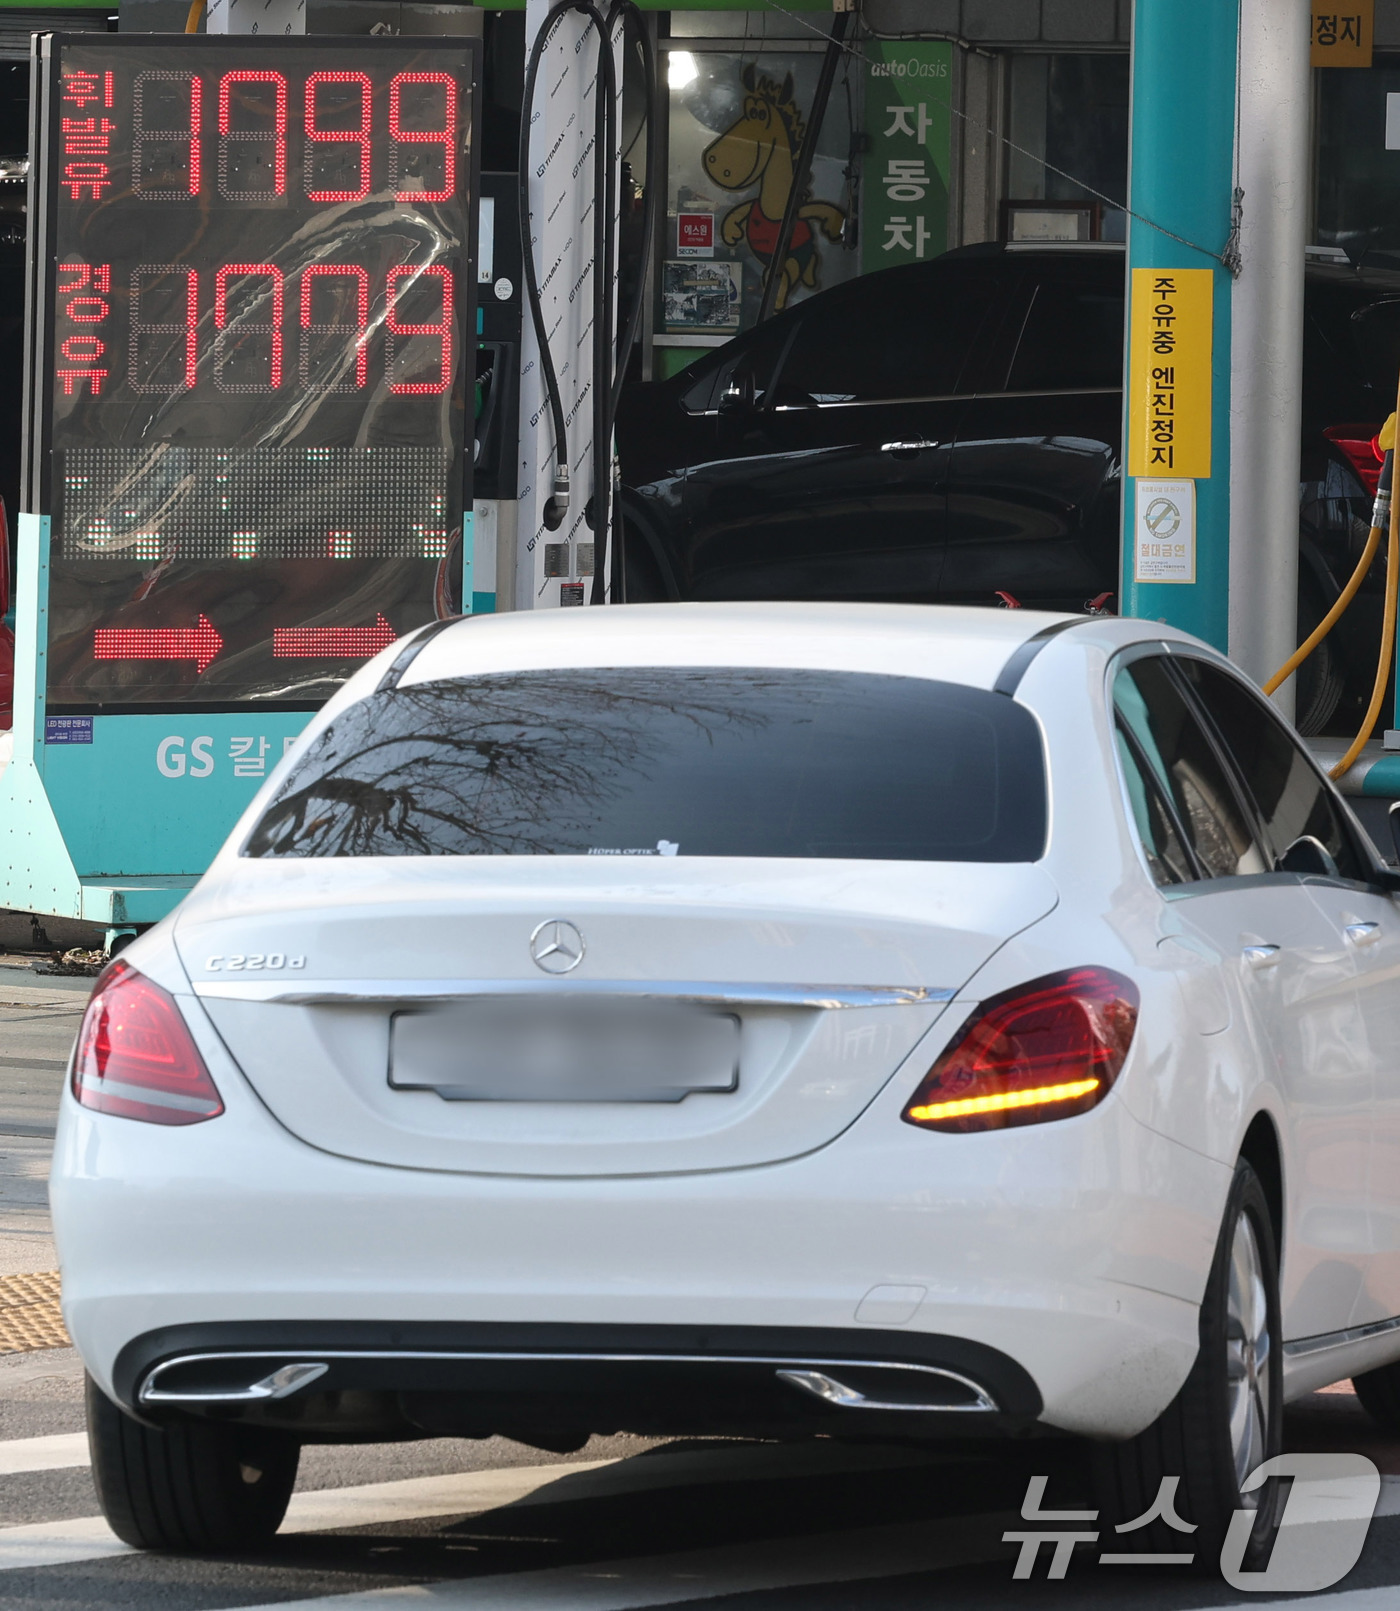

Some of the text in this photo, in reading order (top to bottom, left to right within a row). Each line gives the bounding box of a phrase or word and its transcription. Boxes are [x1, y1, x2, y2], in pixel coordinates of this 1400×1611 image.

[871, 58, 947, 78] autoOasis
[1310, 14, 1361, 47] 정지
[61, 70, 116, 200] 휘발유
[189, 70, 457, 202] 1799
[881, 102, 933, 258] 자동차
[683, 224, 708, 236] 에스원
[57, 263, 111, 395] 경유
[186, 263, 454, 394] 1779
[1152, 278, 1177, 355] 주유중
[1150, 367, 1175, 469] 엔진정지
[1141, 543, 1186, 558] 절대금연
[156, 735, 299, 778] GS 칼
